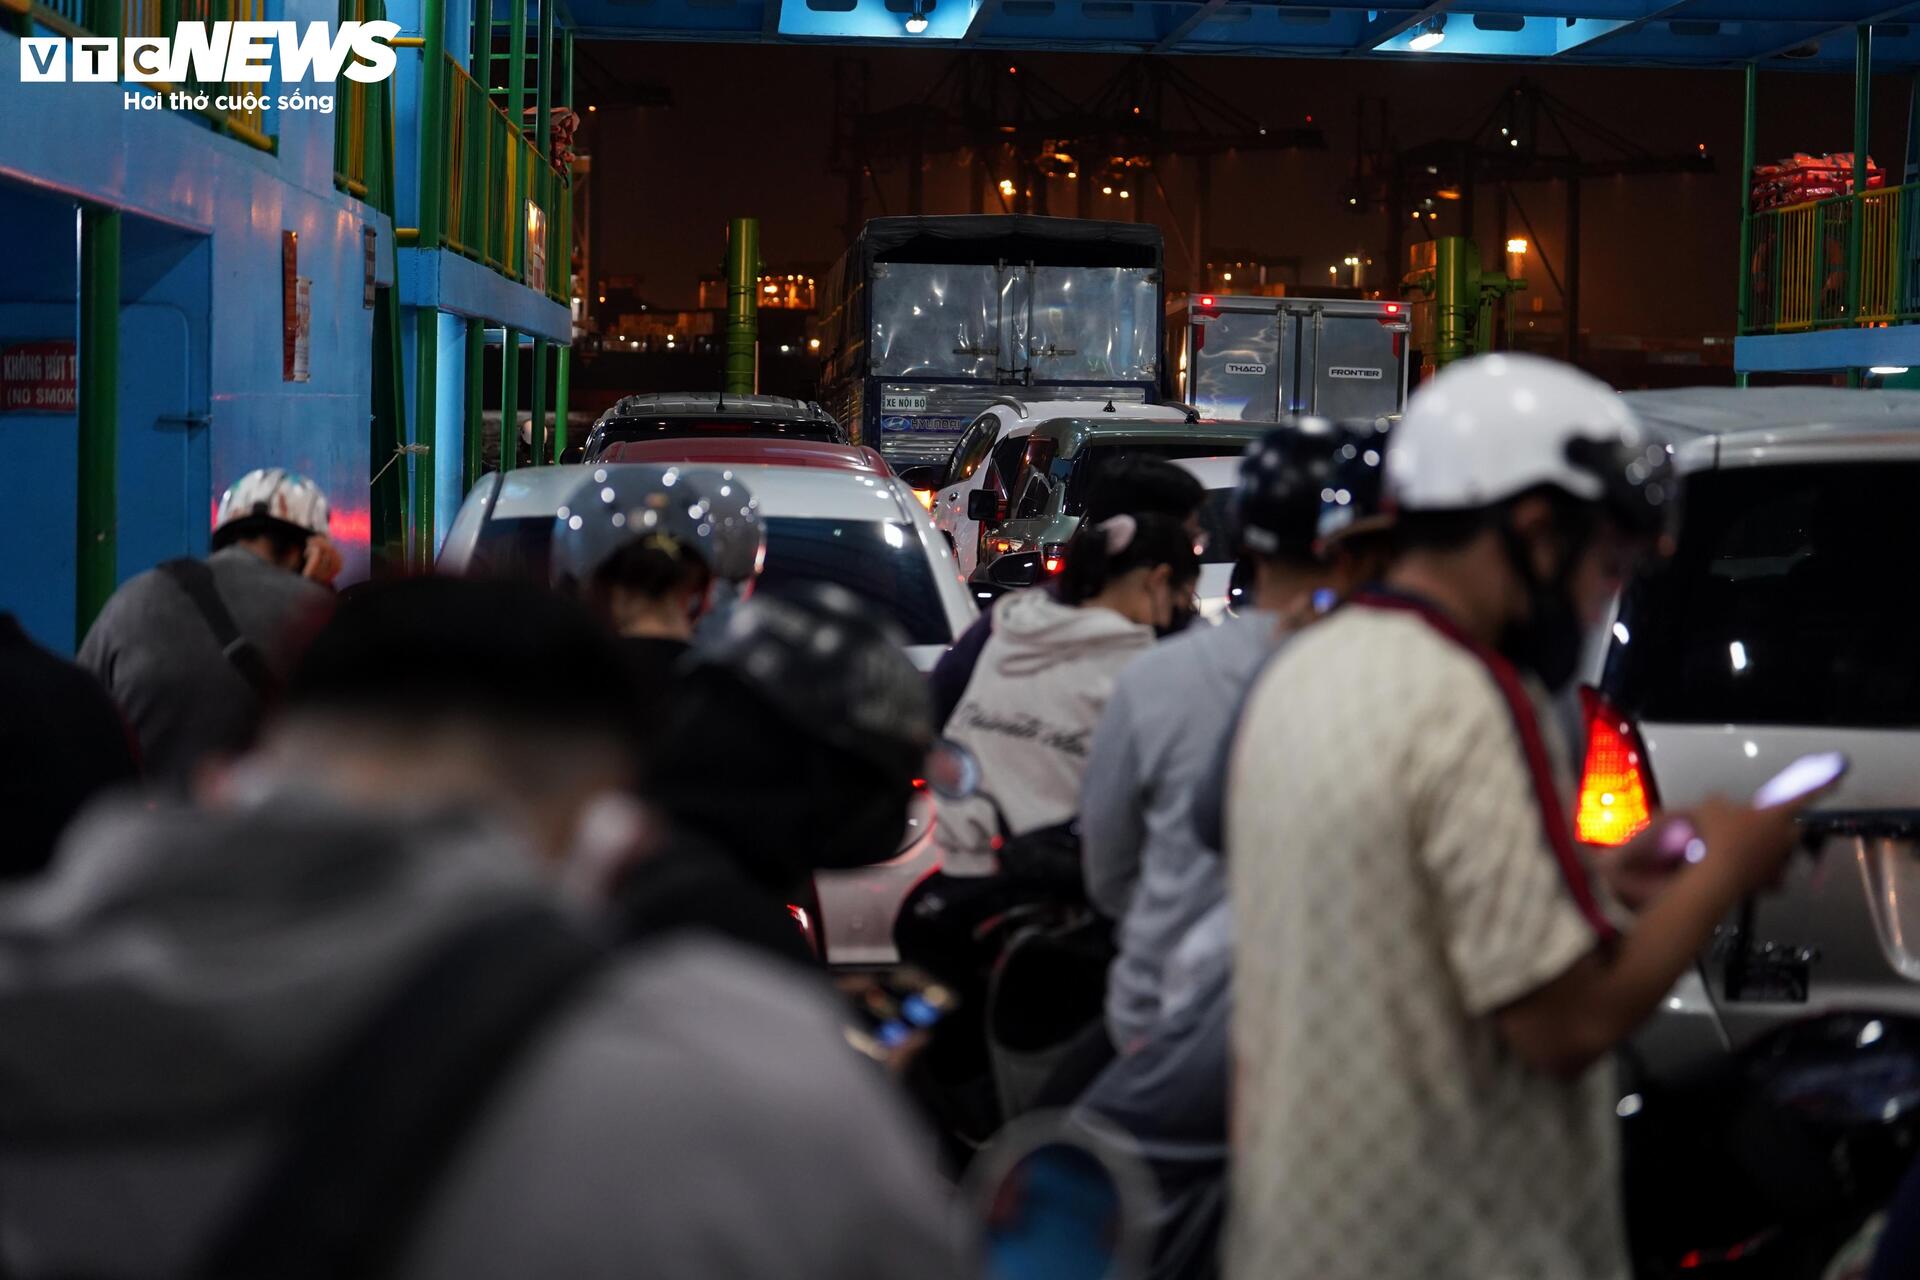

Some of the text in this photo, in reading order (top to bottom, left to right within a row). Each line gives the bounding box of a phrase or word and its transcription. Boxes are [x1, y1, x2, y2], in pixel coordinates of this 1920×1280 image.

[4, 350, 42, 380] KHÔNG
[45, 350, 67, 380] HÚT
[1228, 364, 1264, 373] THACO
[1331, 368, 1380, 377] FRONTIER
[886, 398, 896, 408] XE
[898, 396, 912, 409] NỘI
[911, 418, 961, 430] HYUNDAI
